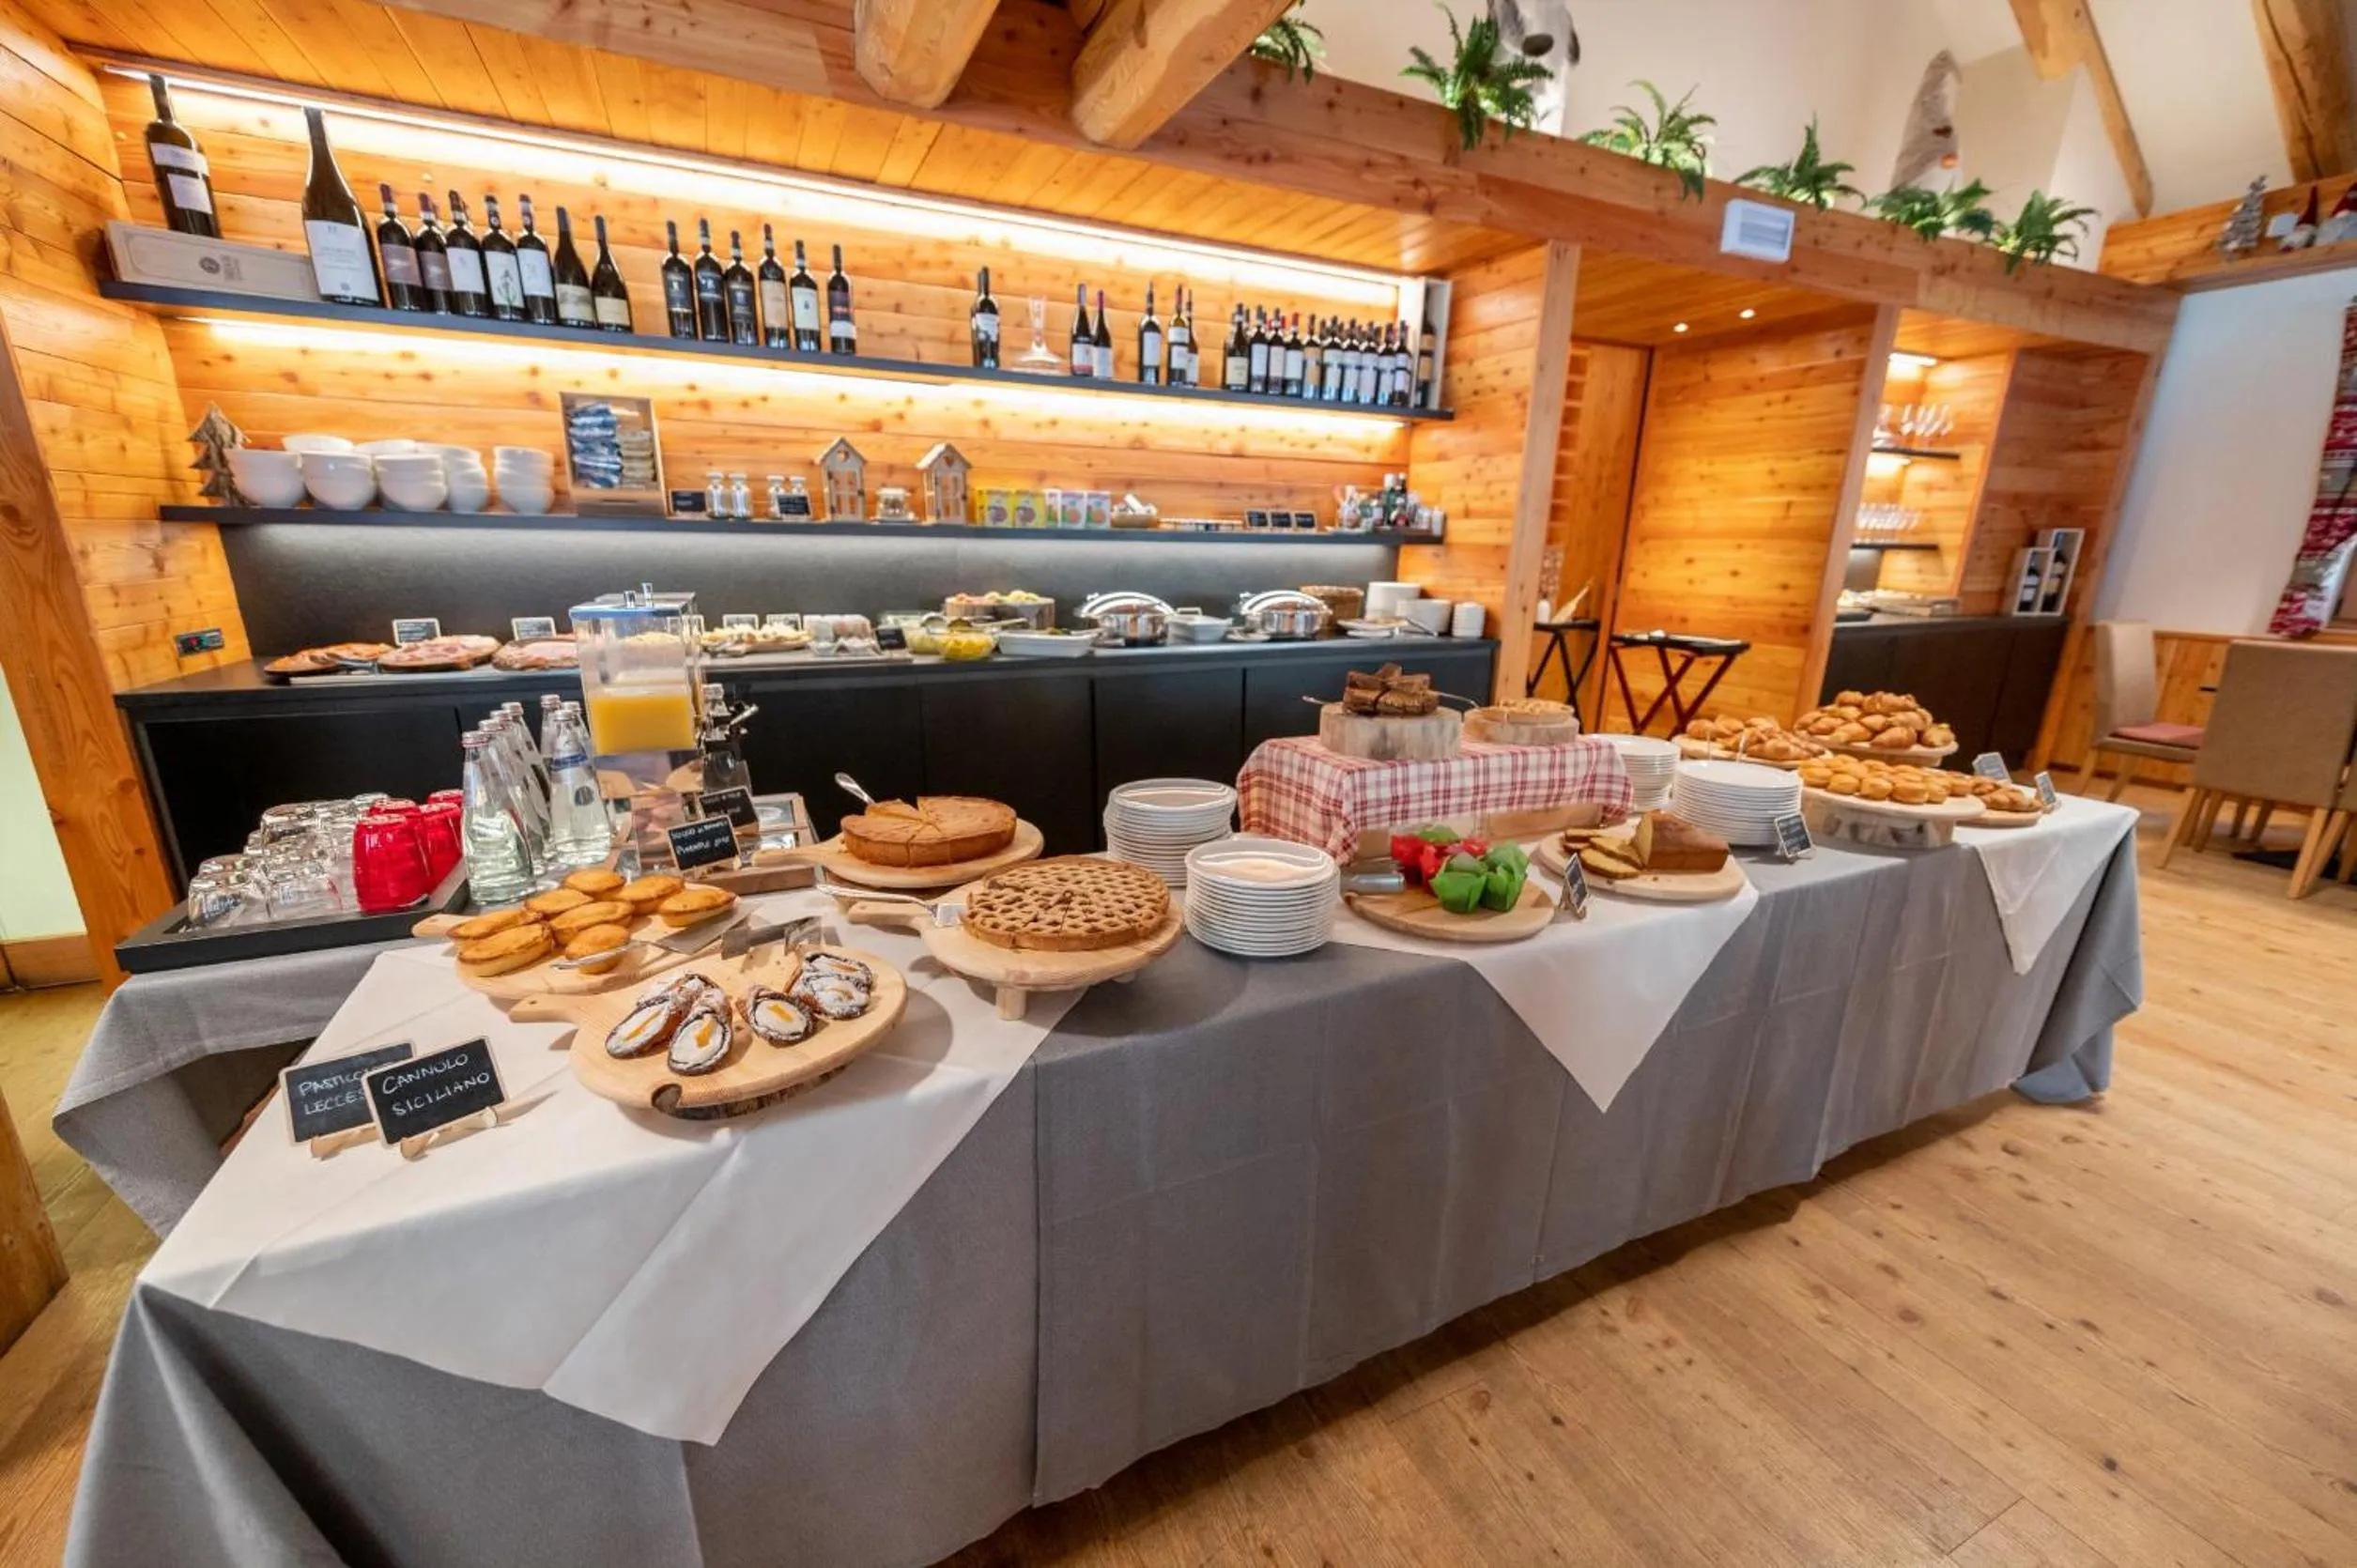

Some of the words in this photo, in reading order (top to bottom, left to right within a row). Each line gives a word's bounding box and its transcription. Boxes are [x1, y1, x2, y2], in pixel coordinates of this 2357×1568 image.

[299, 1068, 369, 1097] PASTICC
[382, 1053, 469, 1095] CANNOLO
[392, 1071, 490, 1116] SICILIANO
